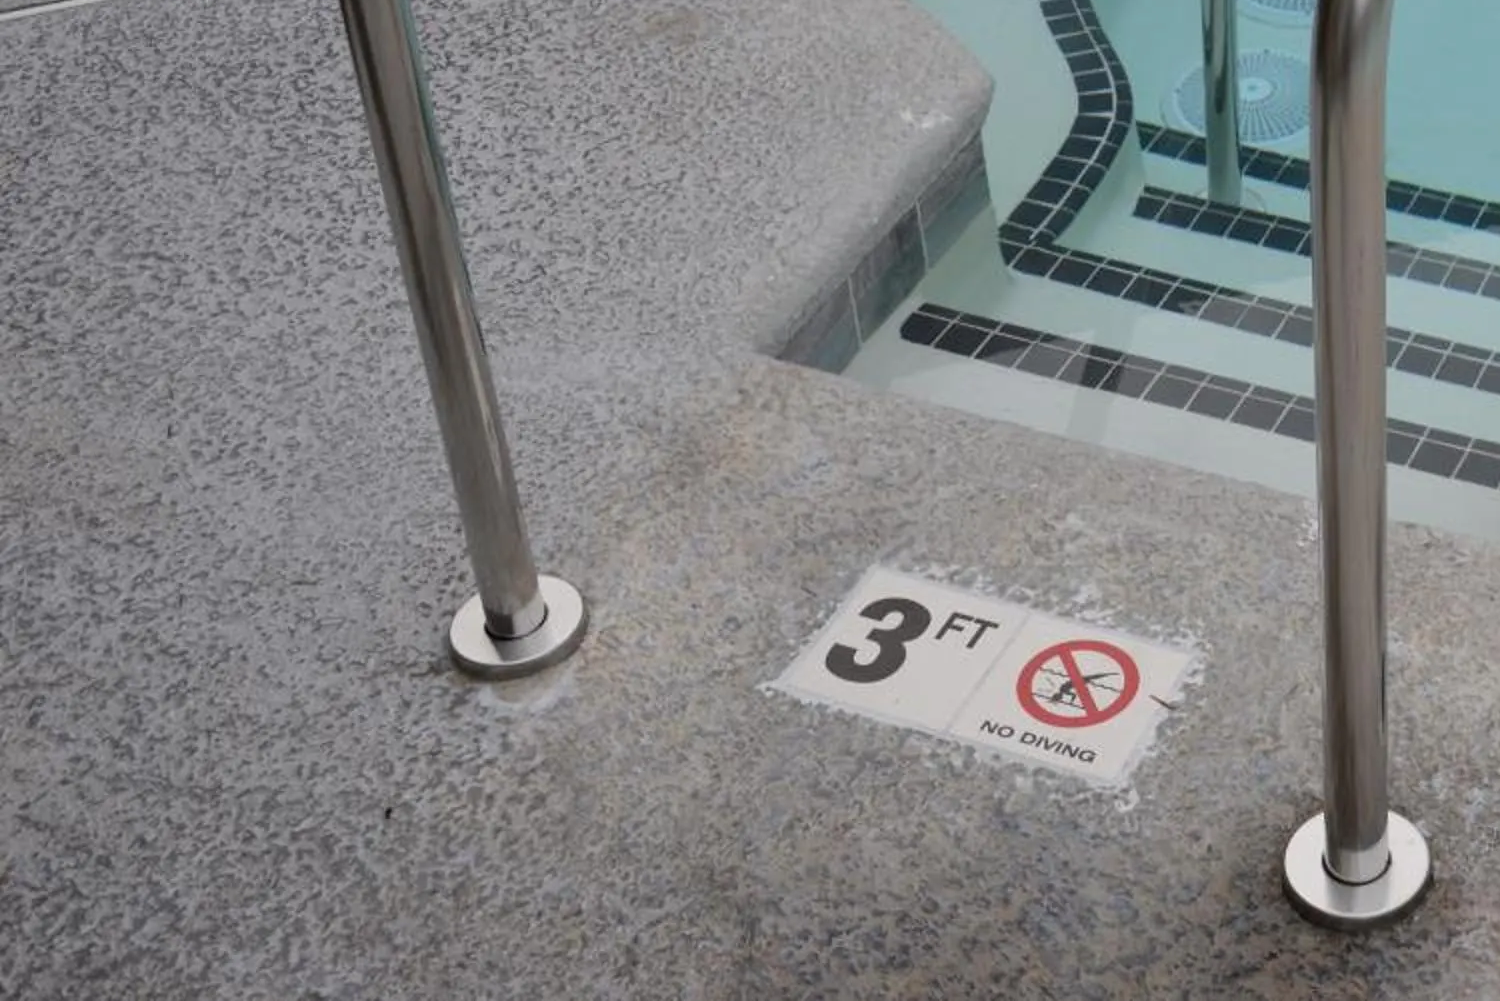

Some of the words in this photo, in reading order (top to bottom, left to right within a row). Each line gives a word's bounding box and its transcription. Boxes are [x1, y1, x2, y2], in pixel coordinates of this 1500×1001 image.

[825, 597, 932, 684] 3
[934, 611, 1000, 649] FT
[979, 719, 1015, 740] NO
[1020, 731, 1098, 764] DIVING
